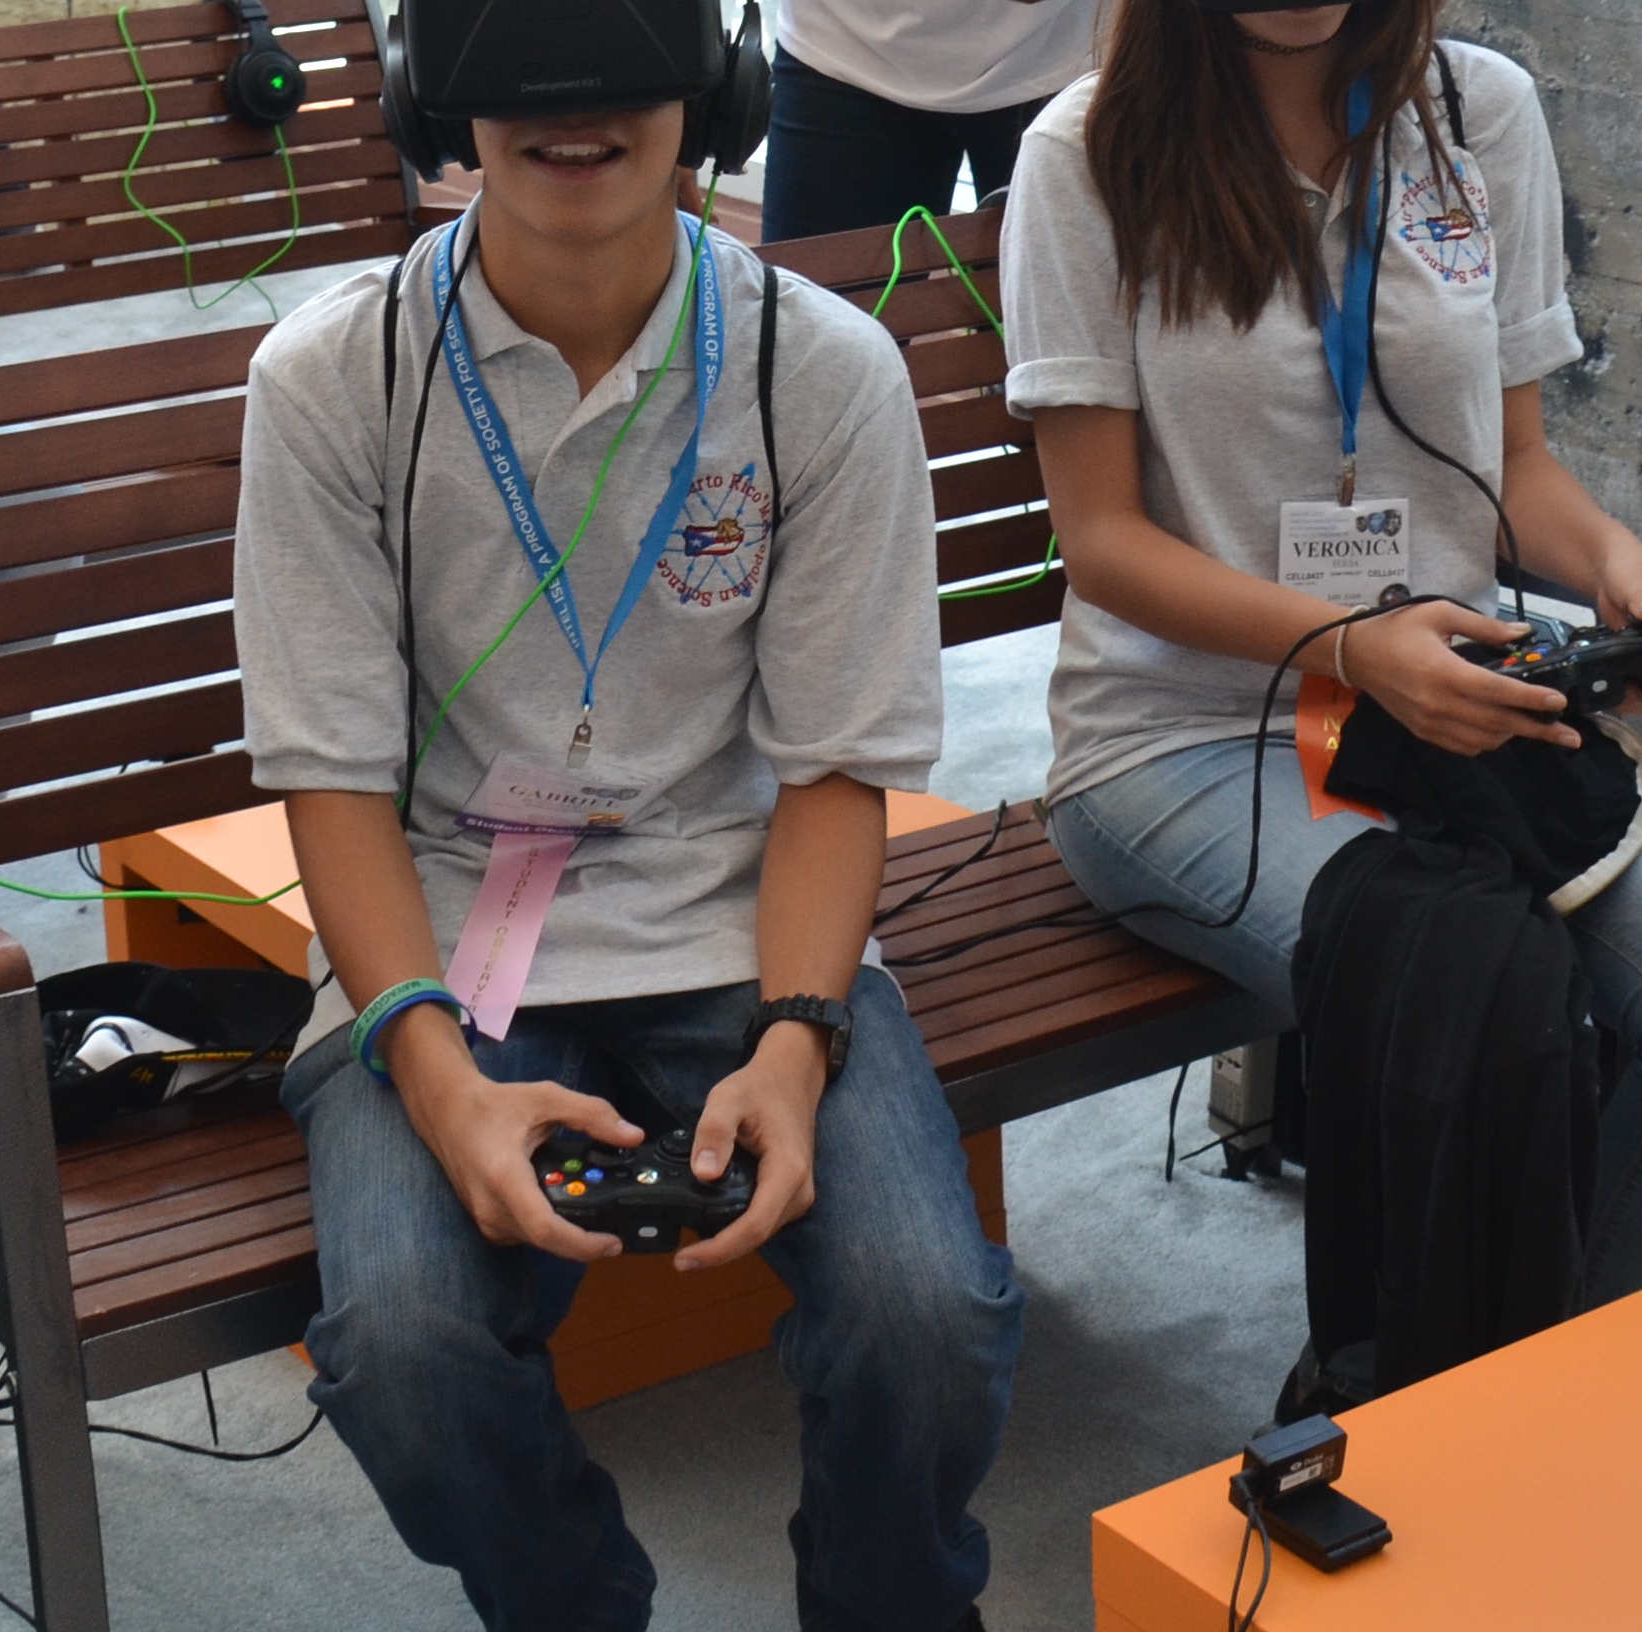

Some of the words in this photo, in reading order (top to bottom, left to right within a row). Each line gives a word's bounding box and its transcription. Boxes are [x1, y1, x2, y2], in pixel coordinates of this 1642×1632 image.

[521, 80, 579, 93] Development
[701, 257, 718, 337] PROGRAM
[704, 339, 720, 363] OF
[453, 353, 474, 385] FOR
[464, 384, 503, 452] SOCIETY
[491, 451, 512, 475] OF
[501, 476, 541, 553] PROGRAM
[538, 552, 553, 566] A
[1293, 538, 1400, 558] VERONICA
[657, 558, 713, 607] Science
[466, 818, 531, 833] Student
